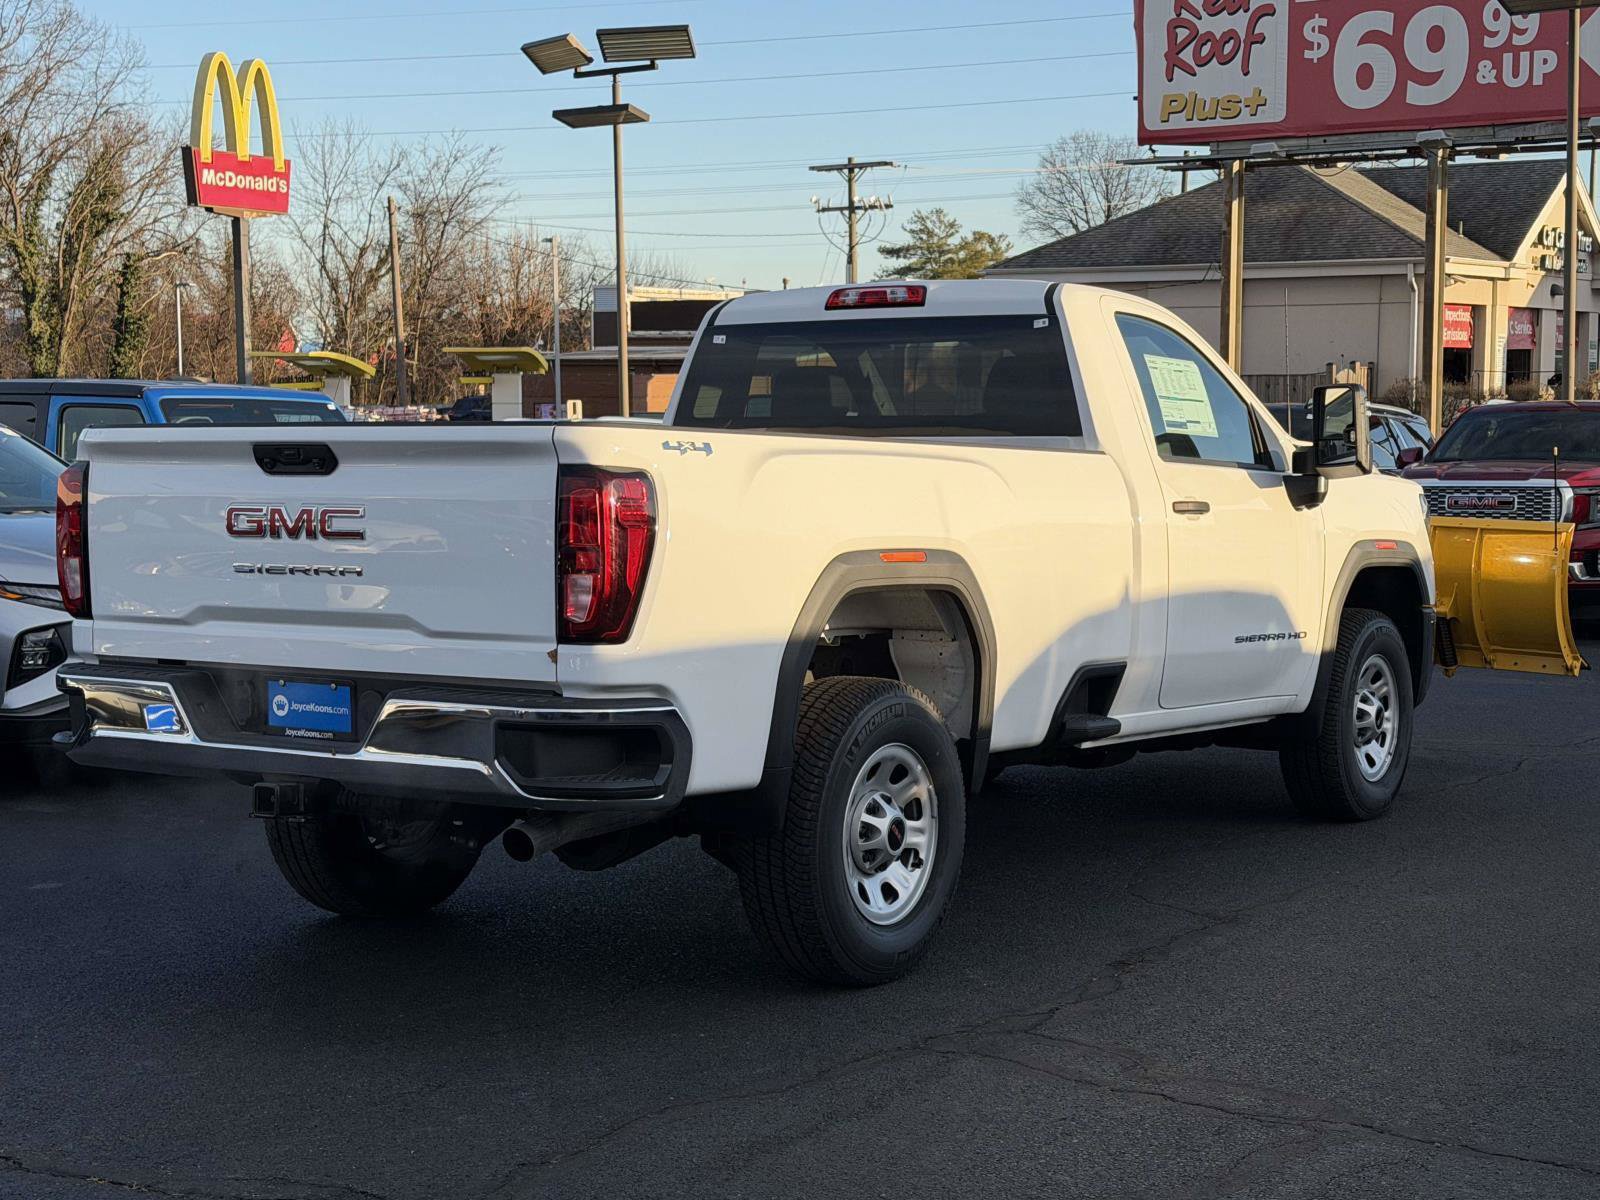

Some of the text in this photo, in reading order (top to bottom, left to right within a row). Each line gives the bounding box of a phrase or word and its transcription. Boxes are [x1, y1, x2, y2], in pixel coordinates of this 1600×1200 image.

[1483, 0, 1540, 48] 99
[1164, 3, 1276, 82] Roof
[202, 168, 288, 193] McDonald's
[1450, 495, 1514, 510] GMC
[226, 503, 366, 540] GMC
[232, 562, 364, 577] SIERRA
[1234, 631, 1307, 644] SIERRA HD
[290, 700, 349, 715] JoyceKoons.com
[284, 727, 334, 739] JoyceKoons.com
